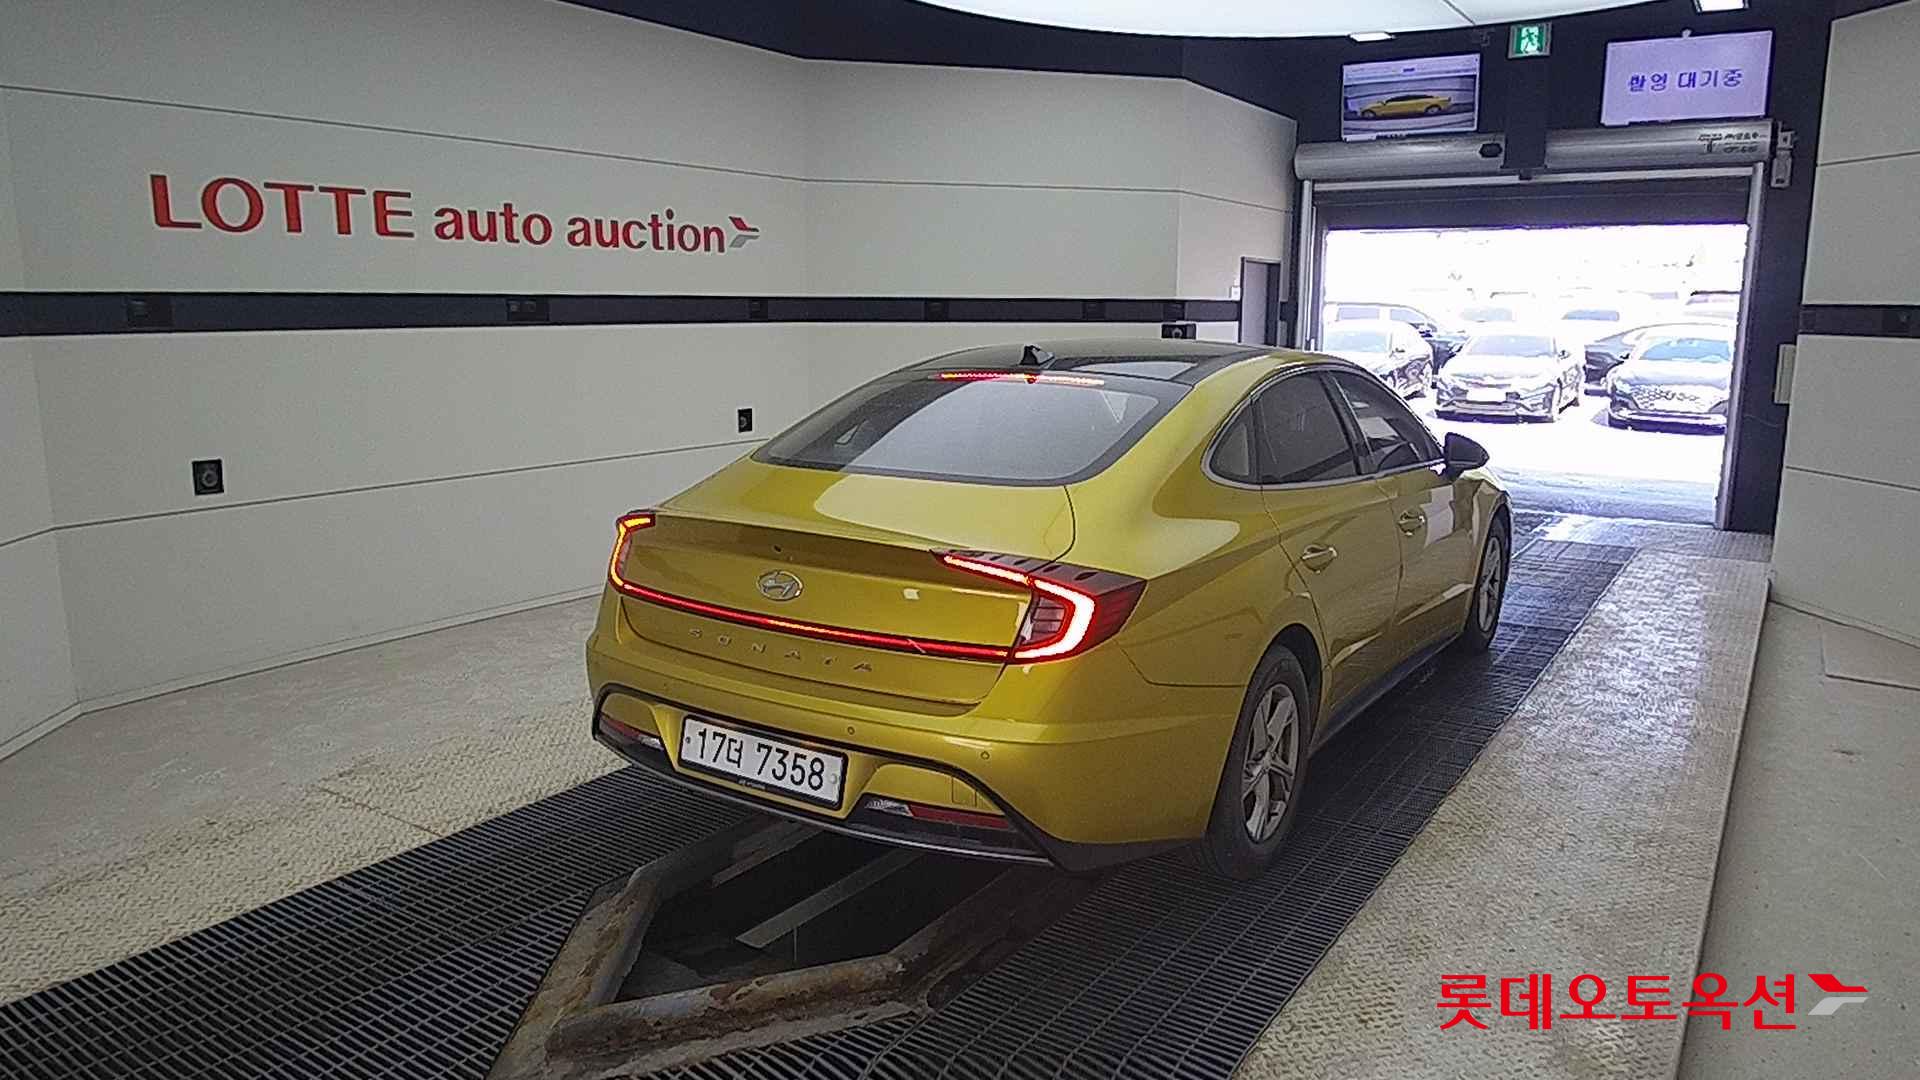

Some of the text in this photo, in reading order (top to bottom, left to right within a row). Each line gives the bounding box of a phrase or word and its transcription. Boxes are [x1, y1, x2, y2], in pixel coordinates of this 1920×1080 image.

[1678, 69, 1742, 89] 대기중
[149, 174, 726, 253] LOTTE auto auction
[689, 628, 872, 672] SONATA
[698, 728, 825, 791] 17더 7358
